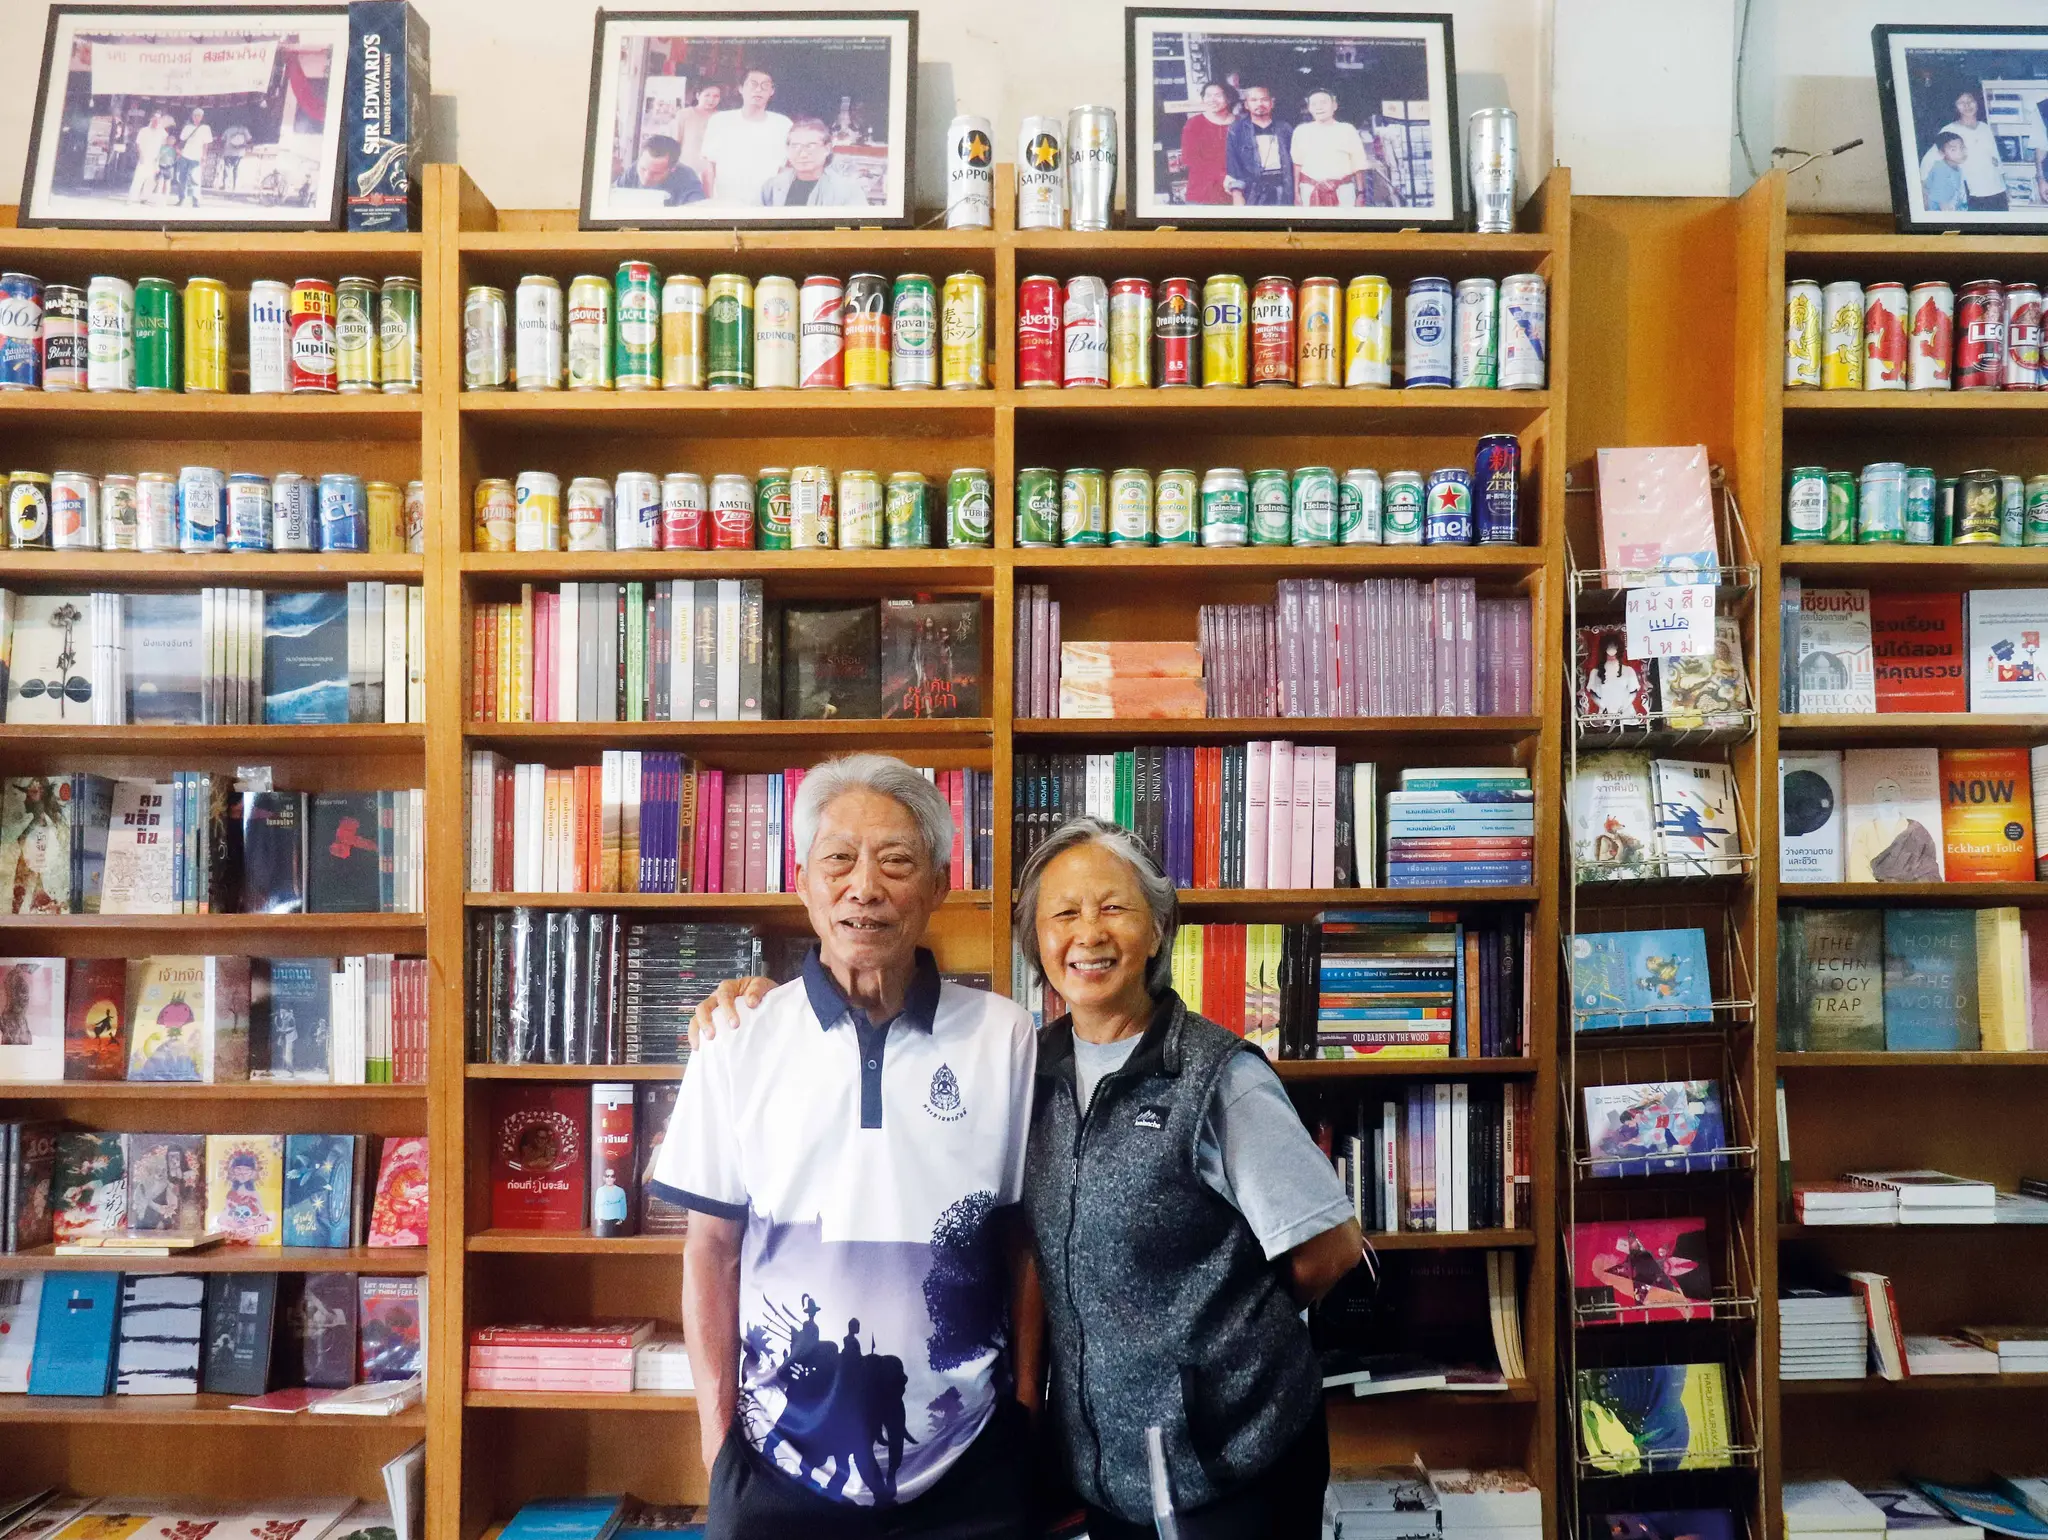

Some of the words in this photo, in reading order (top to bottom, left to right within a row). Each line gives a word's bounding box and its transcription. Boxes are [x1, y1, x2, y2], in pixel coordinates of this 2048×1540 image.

[384, 52, 392, 80] WHISKY
[363, 33, 381, 119] EDWARD'S
[384, 79, 392, 106] SCOTCH
[384, 106, 392, 135] BLENDED
[363, 123, 380, 155] SIR
[1203, 304, 1242, 327] OB
[1252, 304, 1291, 320] TAPPER
[756, 331, 796, 341] ERDINGER
[846, 325, 886, 335] ORIGINAL
[11, 487, 44, 506] TUSKER
[664, 500, 697, 508] AMSTEL
[718, 500, 752, 509] AMSTEL
[1210, 504, 1242, 513] Heineken
[1387, 504, 1420, 512] Heineken
[664, 509, 697, 521] Zero
[720, 508, 753, 521] Zero
[1627, 588, 1713, 613] หนังสือ
[1649, 612, 1690, 630] แปล
[1642, 635, 1693, 655] ใหม่
[1015, 776, 1023, 807] LAPVONA
[1947, 779, 2016, 805] NOW
[139, 794, 162, 807] คน
[1947, 842, 1991, 854] Eckhart
[1994, 842, 2024, 853] Tolle
[1819, 936, 1854, 949] THE
[1904, 934, 1959, 949] HOME
[1807, 957, 1868, 971] TECHN
[1916, 975, 1951, 989] THE
[1815, 997, 1862, 1013] TRAP
[1899, 995, 1967, 1010] WORLD
[1353, 1033, 1366, 1042] OLD
[1366, 1033, 1386, 1042] BABES
[1387, 1033, 1395, 1042] IN
[1397, 1033, 1409, 1042] THE
[1410, 1033, 1430, 1042] WOOD
[1703, 1373, 1715, 1407] HARUKI
